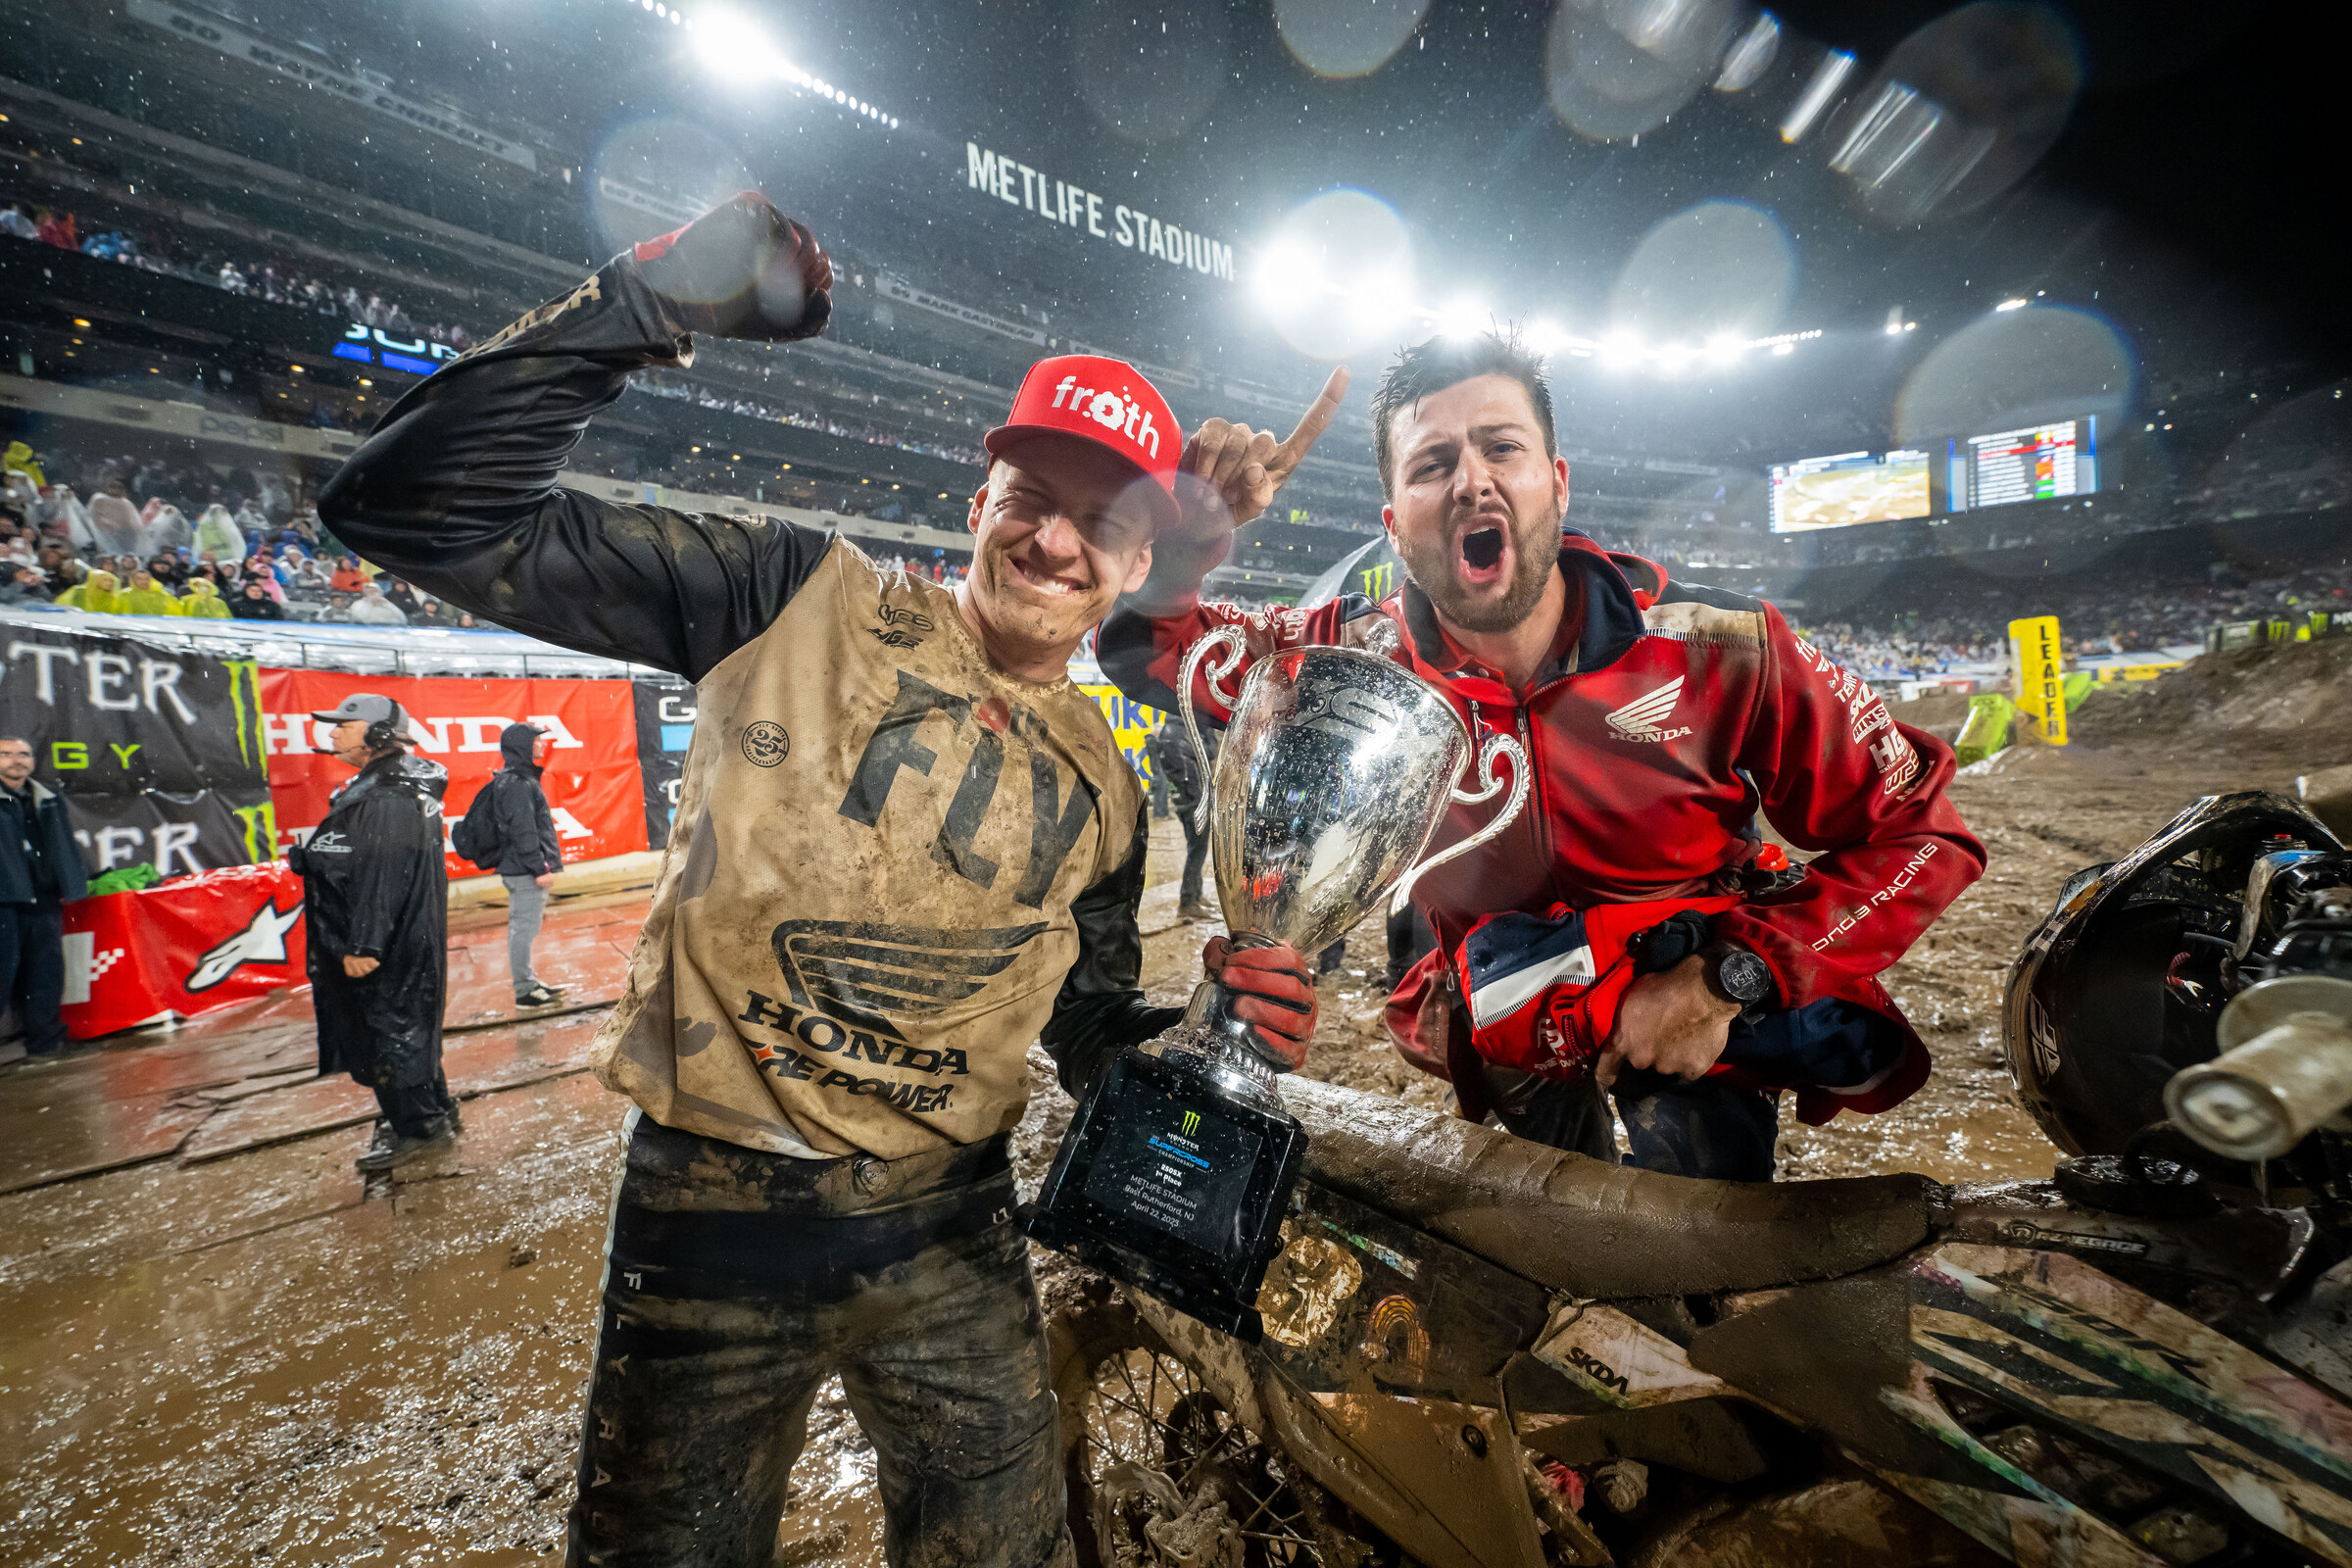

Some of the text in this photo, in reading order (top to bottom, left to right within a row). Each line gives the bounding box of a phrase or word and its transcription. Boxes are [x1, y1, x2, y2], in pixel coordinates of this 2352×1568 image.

[966, 141, 1235, 283] METLIFE STADIUM
[1052, 375, 1160, 461] froth
[0, 640, 197, 725] TER
[2039, 624, 2060, 737] LEADER
[1607, 725, 1693, 743] HONDA
[837, 668, 1102, 911] FLY
[1870, 842, 1939, 906] RACING
[737, 989, 971, 1076] HONDA
[1149, 1137, 1210, 1169] SUPERCROSS
[1157, 1149, 1196, 1168] CHAMPIONSHIP
[1166, 1132, 1200, 1152] MONSTER
[1130, 1174, 1198, 1210] METLIFE STADIUM
[1163, 1173, 1182, 1187] Place
[1130, 1200, 1150, 1215] April
[1149, 1207, 1161, 1220] 22,
[1142, 1192, 1182, 1217] Rutherford,
[1183, 1210, 1196, 1221] NJ
